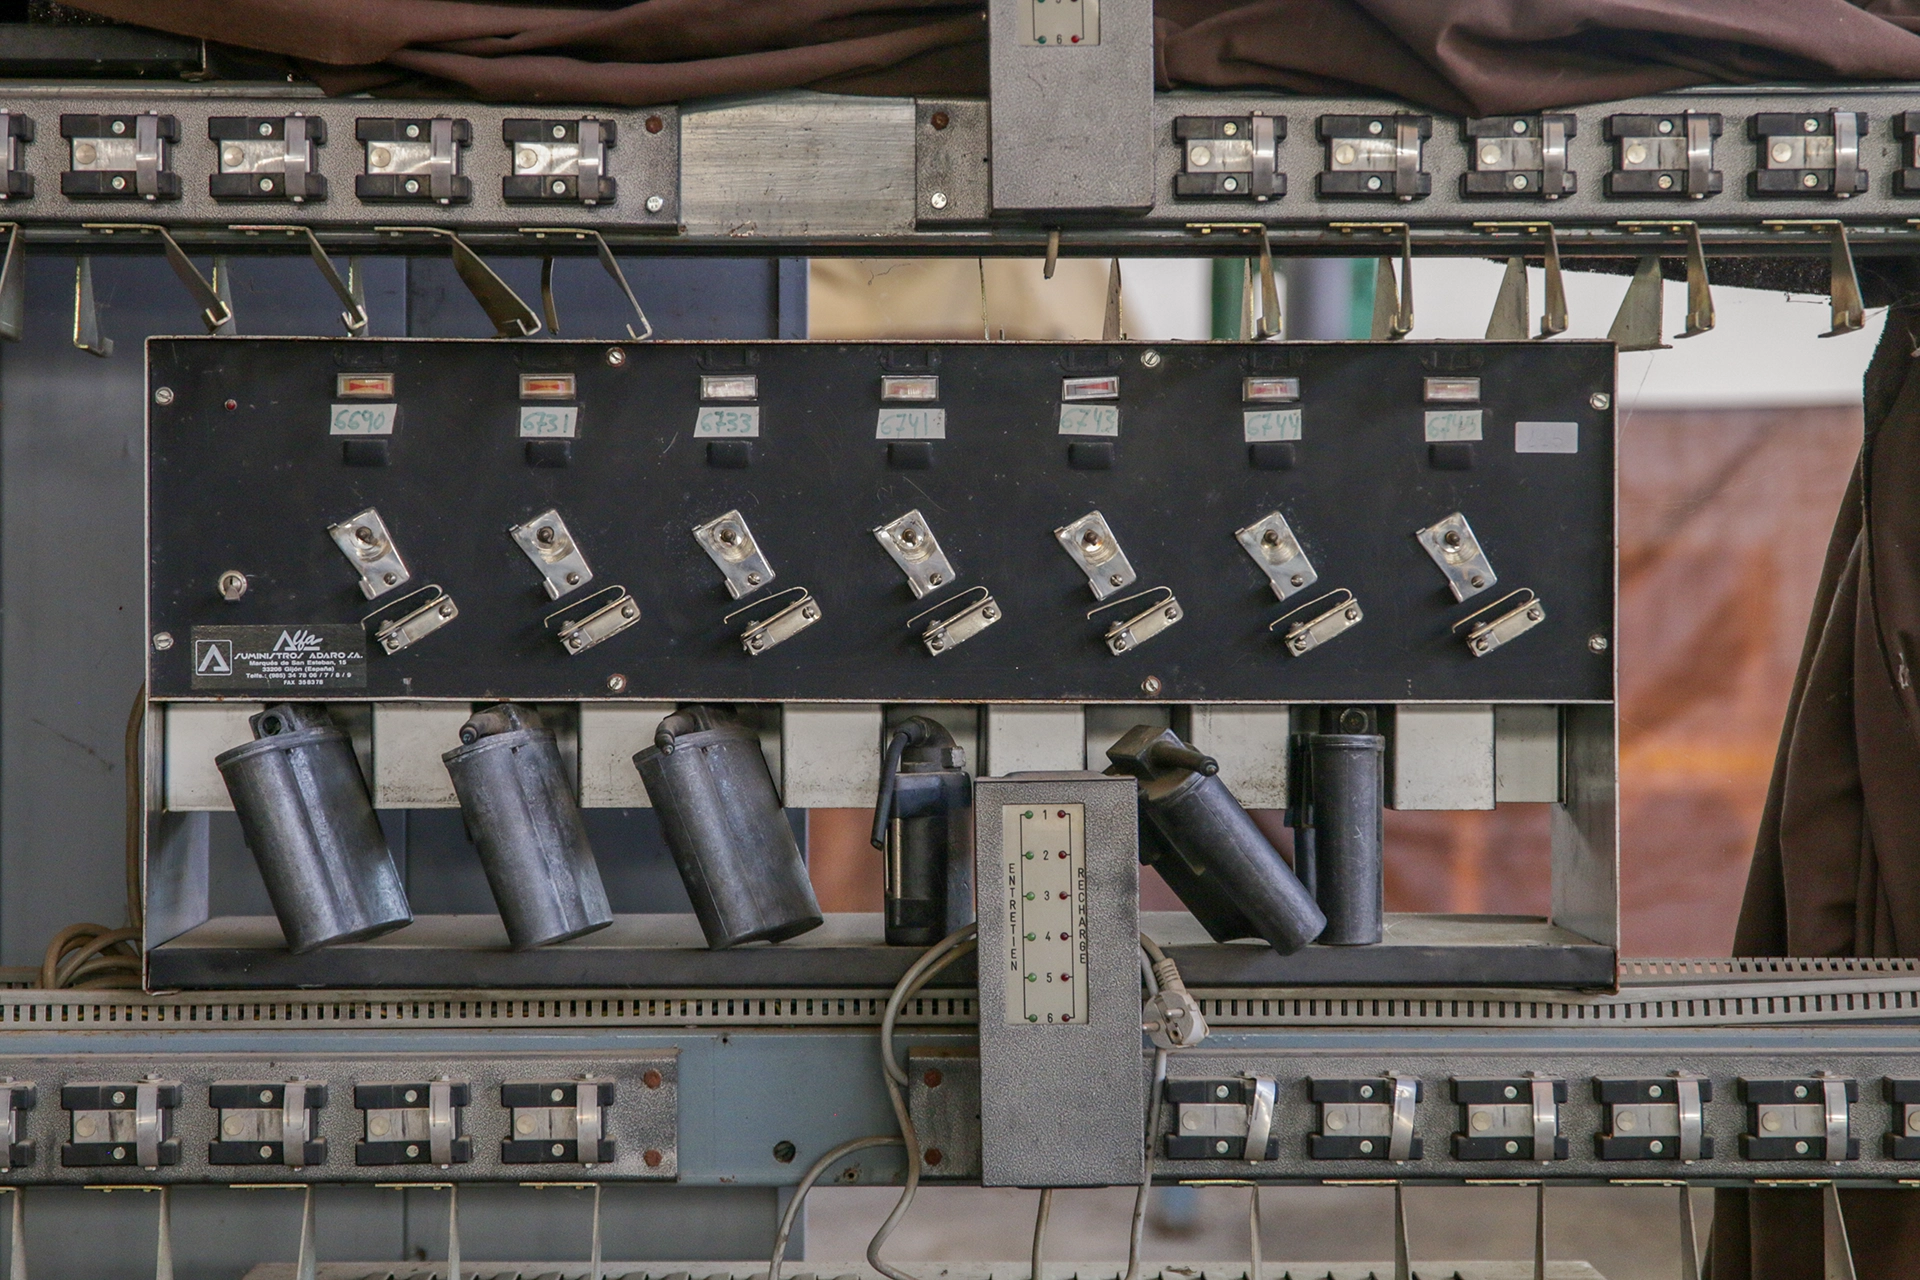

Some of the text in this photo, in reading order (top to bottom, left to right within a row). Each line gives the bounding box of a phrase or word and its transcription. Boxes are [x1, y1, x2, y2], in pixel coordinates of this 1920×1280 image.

[1056, 34, 1063, 45] 6
[334, 409, 385, 433] 6690
[522, 411, 569, 434] 6731
[700, 411, 752, 433] 6733
[880, 412, 928, 438] 6741
[1247, 412, 1300, 438] 6744
[273, 629, 324, 651] Alfa
[234, 652, 304, 660] SUMINISTROS
[309, 652, 346, 660] ADARO
[1042, 809, 1048, 820] 1
[1042, 850, 1050, 861] 2
[1043, 890, 1050, 901] 3
[1008, 863, 1018, 971] ENTRETIEN
[1077, 867, 1087, 964] RECHARGE
[1045, 931, 1052, 941] 4
[1046, 972, 1053, 983] 5
[1047, 1013, 1054, 1023] 6
